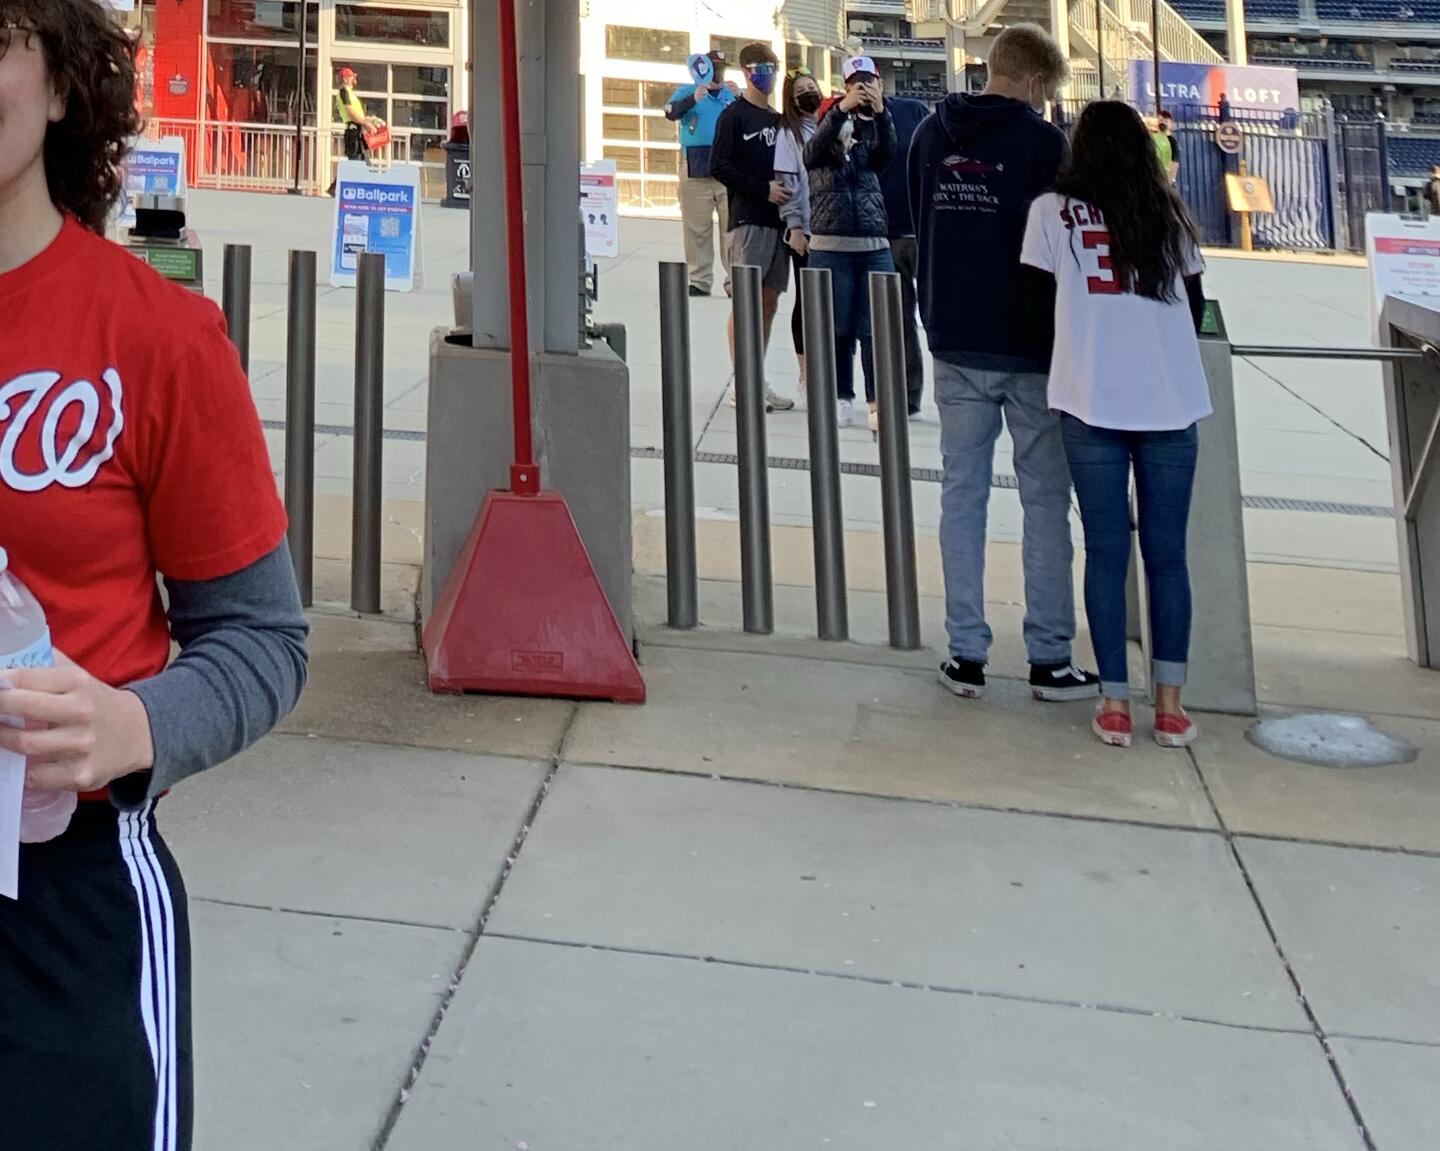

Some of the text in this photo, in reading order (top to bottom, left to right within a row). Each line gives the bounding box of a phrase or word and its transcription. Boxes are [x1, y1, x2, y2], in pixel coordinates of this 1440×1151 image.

[1145, 81, 1282, 105] ULTRA LOFT
[137, 154, 175, 168] Ballpark
[357, 187, 409, 204] Ballpark
